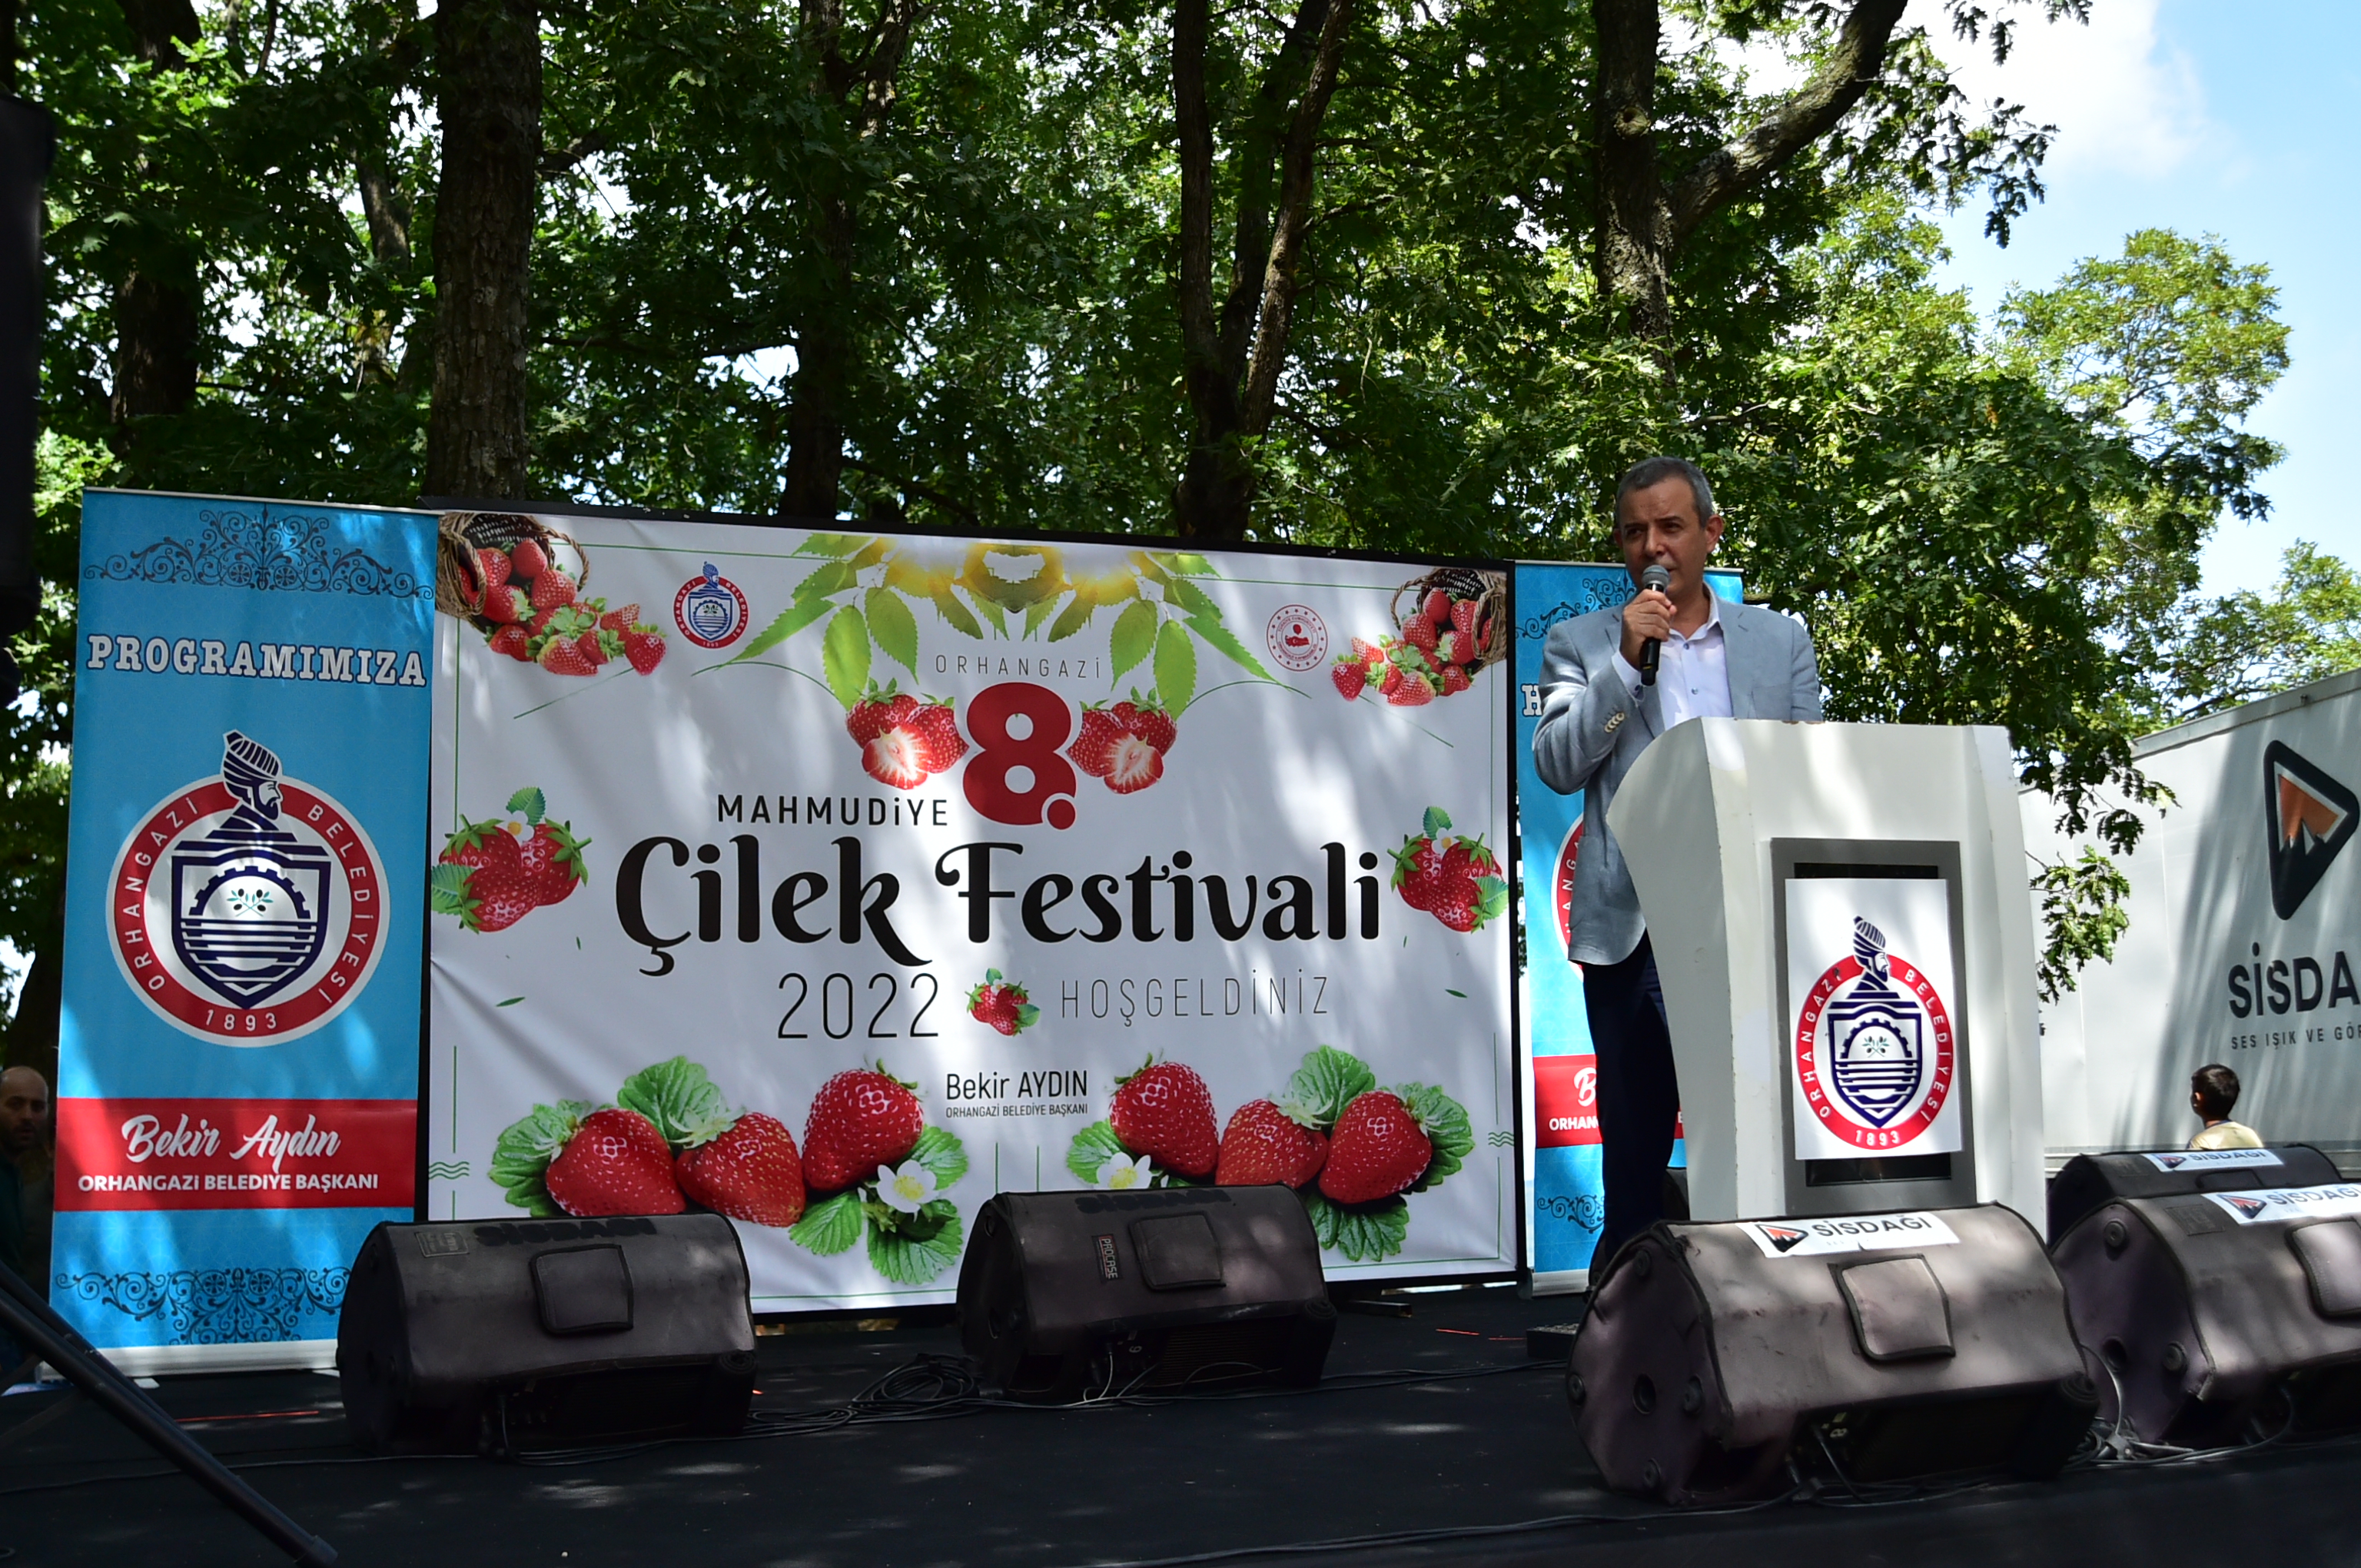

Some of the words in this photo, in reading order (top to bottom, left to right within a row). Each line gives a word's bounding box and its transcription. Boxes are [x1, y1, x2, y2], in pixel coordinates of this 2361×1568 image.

[87, 634, 427, 686] PROGRAMIMIZA
[935, 655, 1100, 679] ORHANGAZİ
[962, 682, 1077, 830] 8.
[125, 798, 199, 990] ORHANGAZİ
[616, 834, 933, 977] Çilek
[935, 841, 1380, 944] Festivali
[2228, 942, 2361, 1018] SİSDA
[204, 1009, 277, 1031] 1893
[778, 972, 939, 1039] 2022
[1061, 968, 1329, 1028] HOŞGELDİNİZ
[2231, 1035, 2256, 1050] SES
[2265, 1031, 2296, 1050] IŞIK
[2306, 1028, 2324, 1042] VE
[946, 1071, 1011, 1100] Bekir
[1018, 1070, 1088, 1098] AYDIN
[945, 1103, 1000, 1118] ORHANGAZİ
[1002, 1102, 1047, 1117] BELEDİYE
[1049, 1103, 1088, 1118] BAŞKANI
[121, 1114, 221, 1163] Bekir
[229, 1113, 341, 1174] Aydın
[1855, 1129, 1901, 1146] 1893
[295, 1173, 379, 1194] BAŞKANI
[1811, 1214, 1933, 1237] SİSDAĞI
[1101, 1238, 1118, 1280] PROCASE
